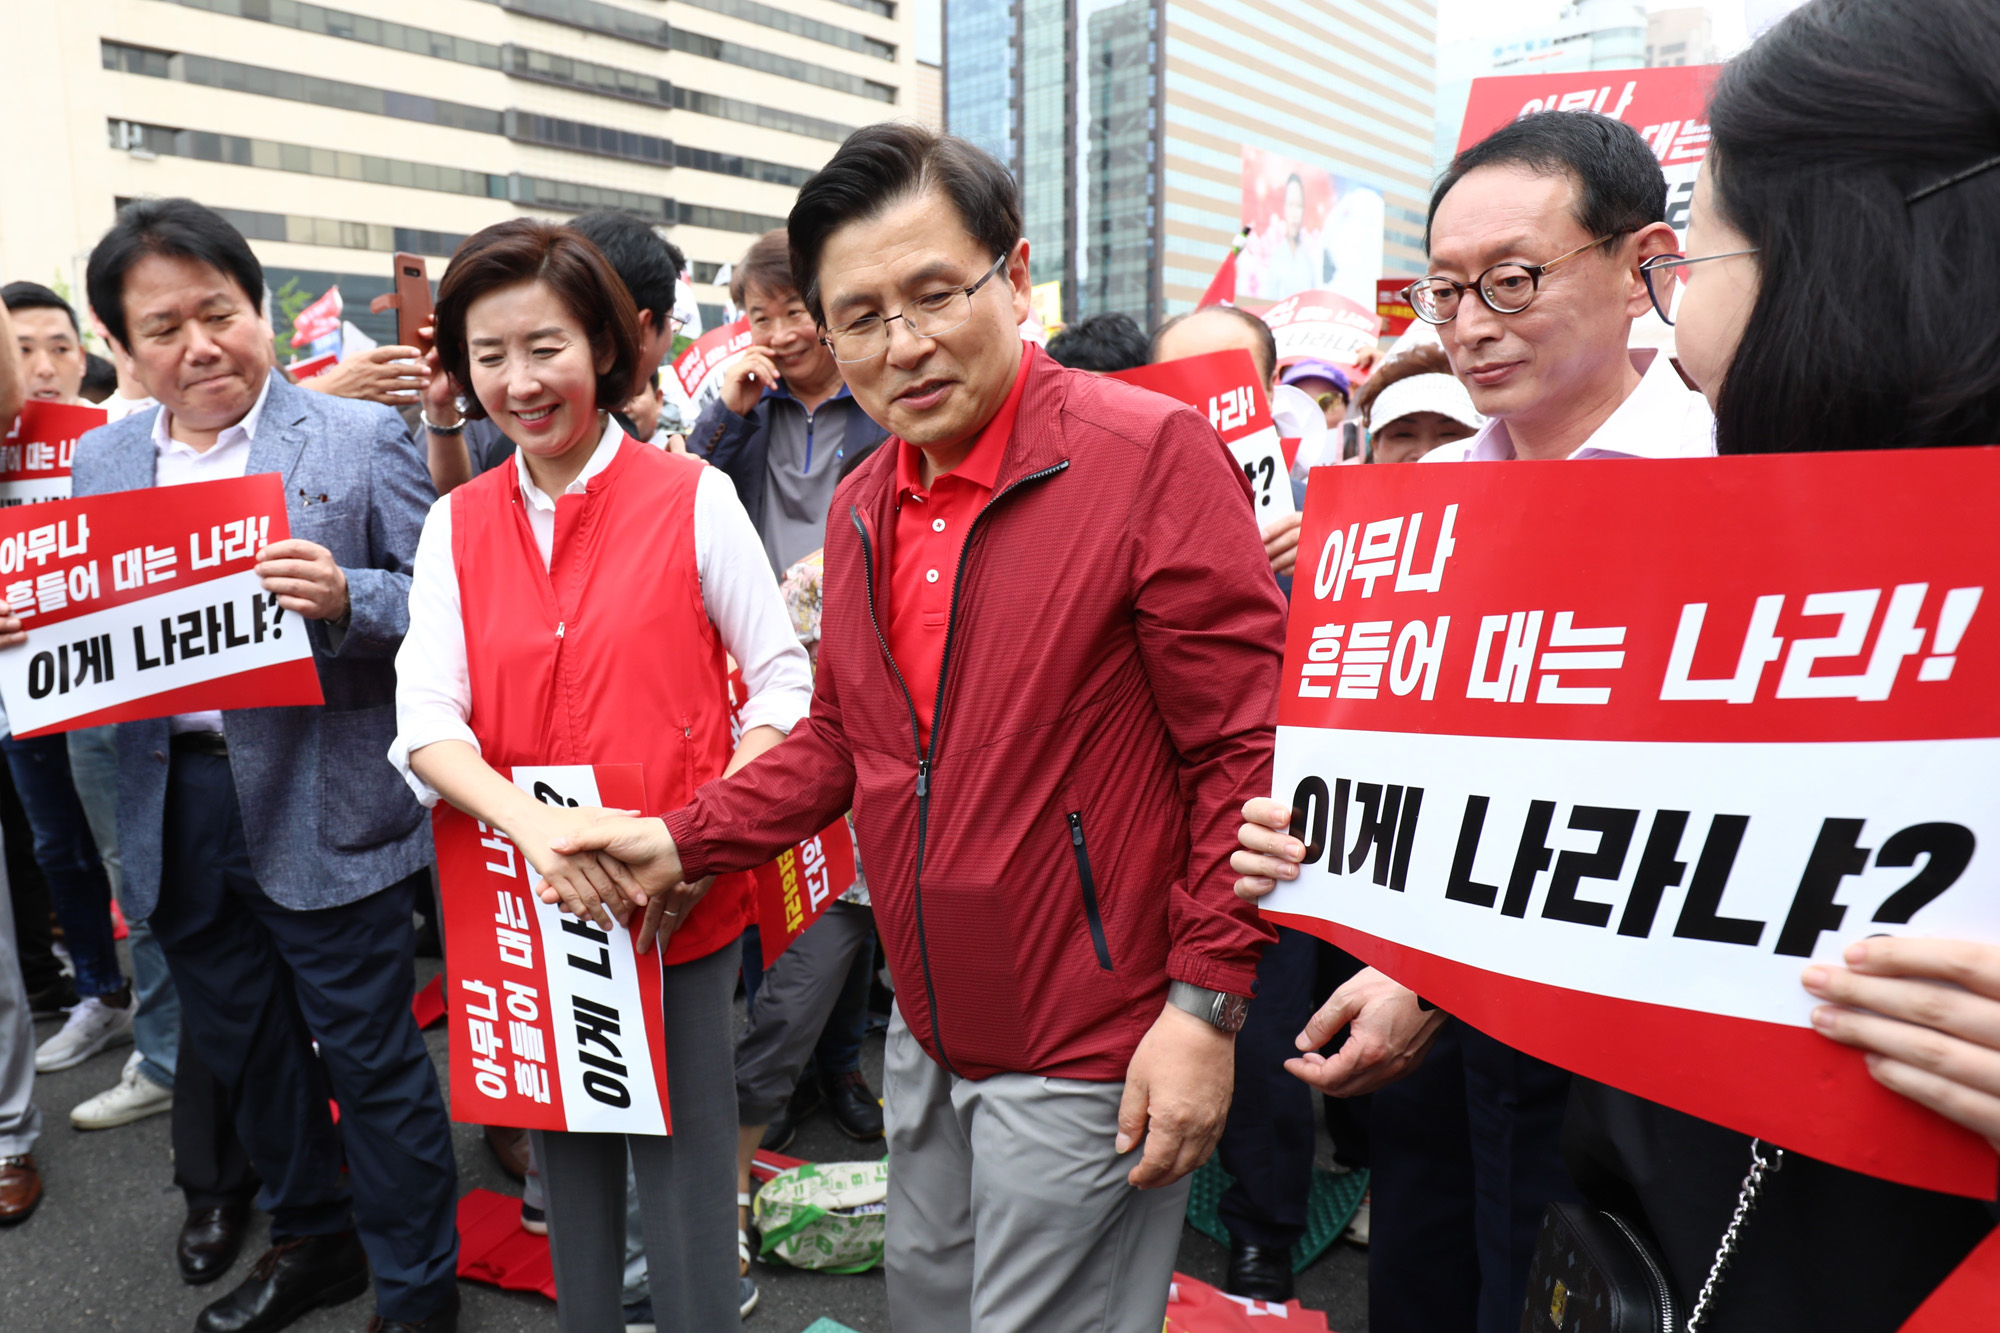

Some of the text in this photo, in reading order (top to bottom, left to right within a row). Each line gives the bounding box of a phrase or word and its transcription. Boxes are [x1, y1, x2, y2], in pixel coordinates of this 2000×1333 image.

[26, 441, 55, 470] 대는
[0, 513, 90, 574] 아무나
[5, 515, 270, 620] 흔들어 대는 나라!
[1313, 503, 1458, 602] 아무나
[28, 592, 285, 699] 이게 나라냐?
[1298, 582, 1984, 705] 흔들어 대는 나라!
[800, 835, 829, 913] 하고
[1289, 775, 1977, 959] 이게 나라냐?
[494, 890, 534, 969] 대는
[461, 979, 507, 1100] 아무나
[502, 980, 551, 1105] 흔들어
[571, 994, 632, 1109] 이게
